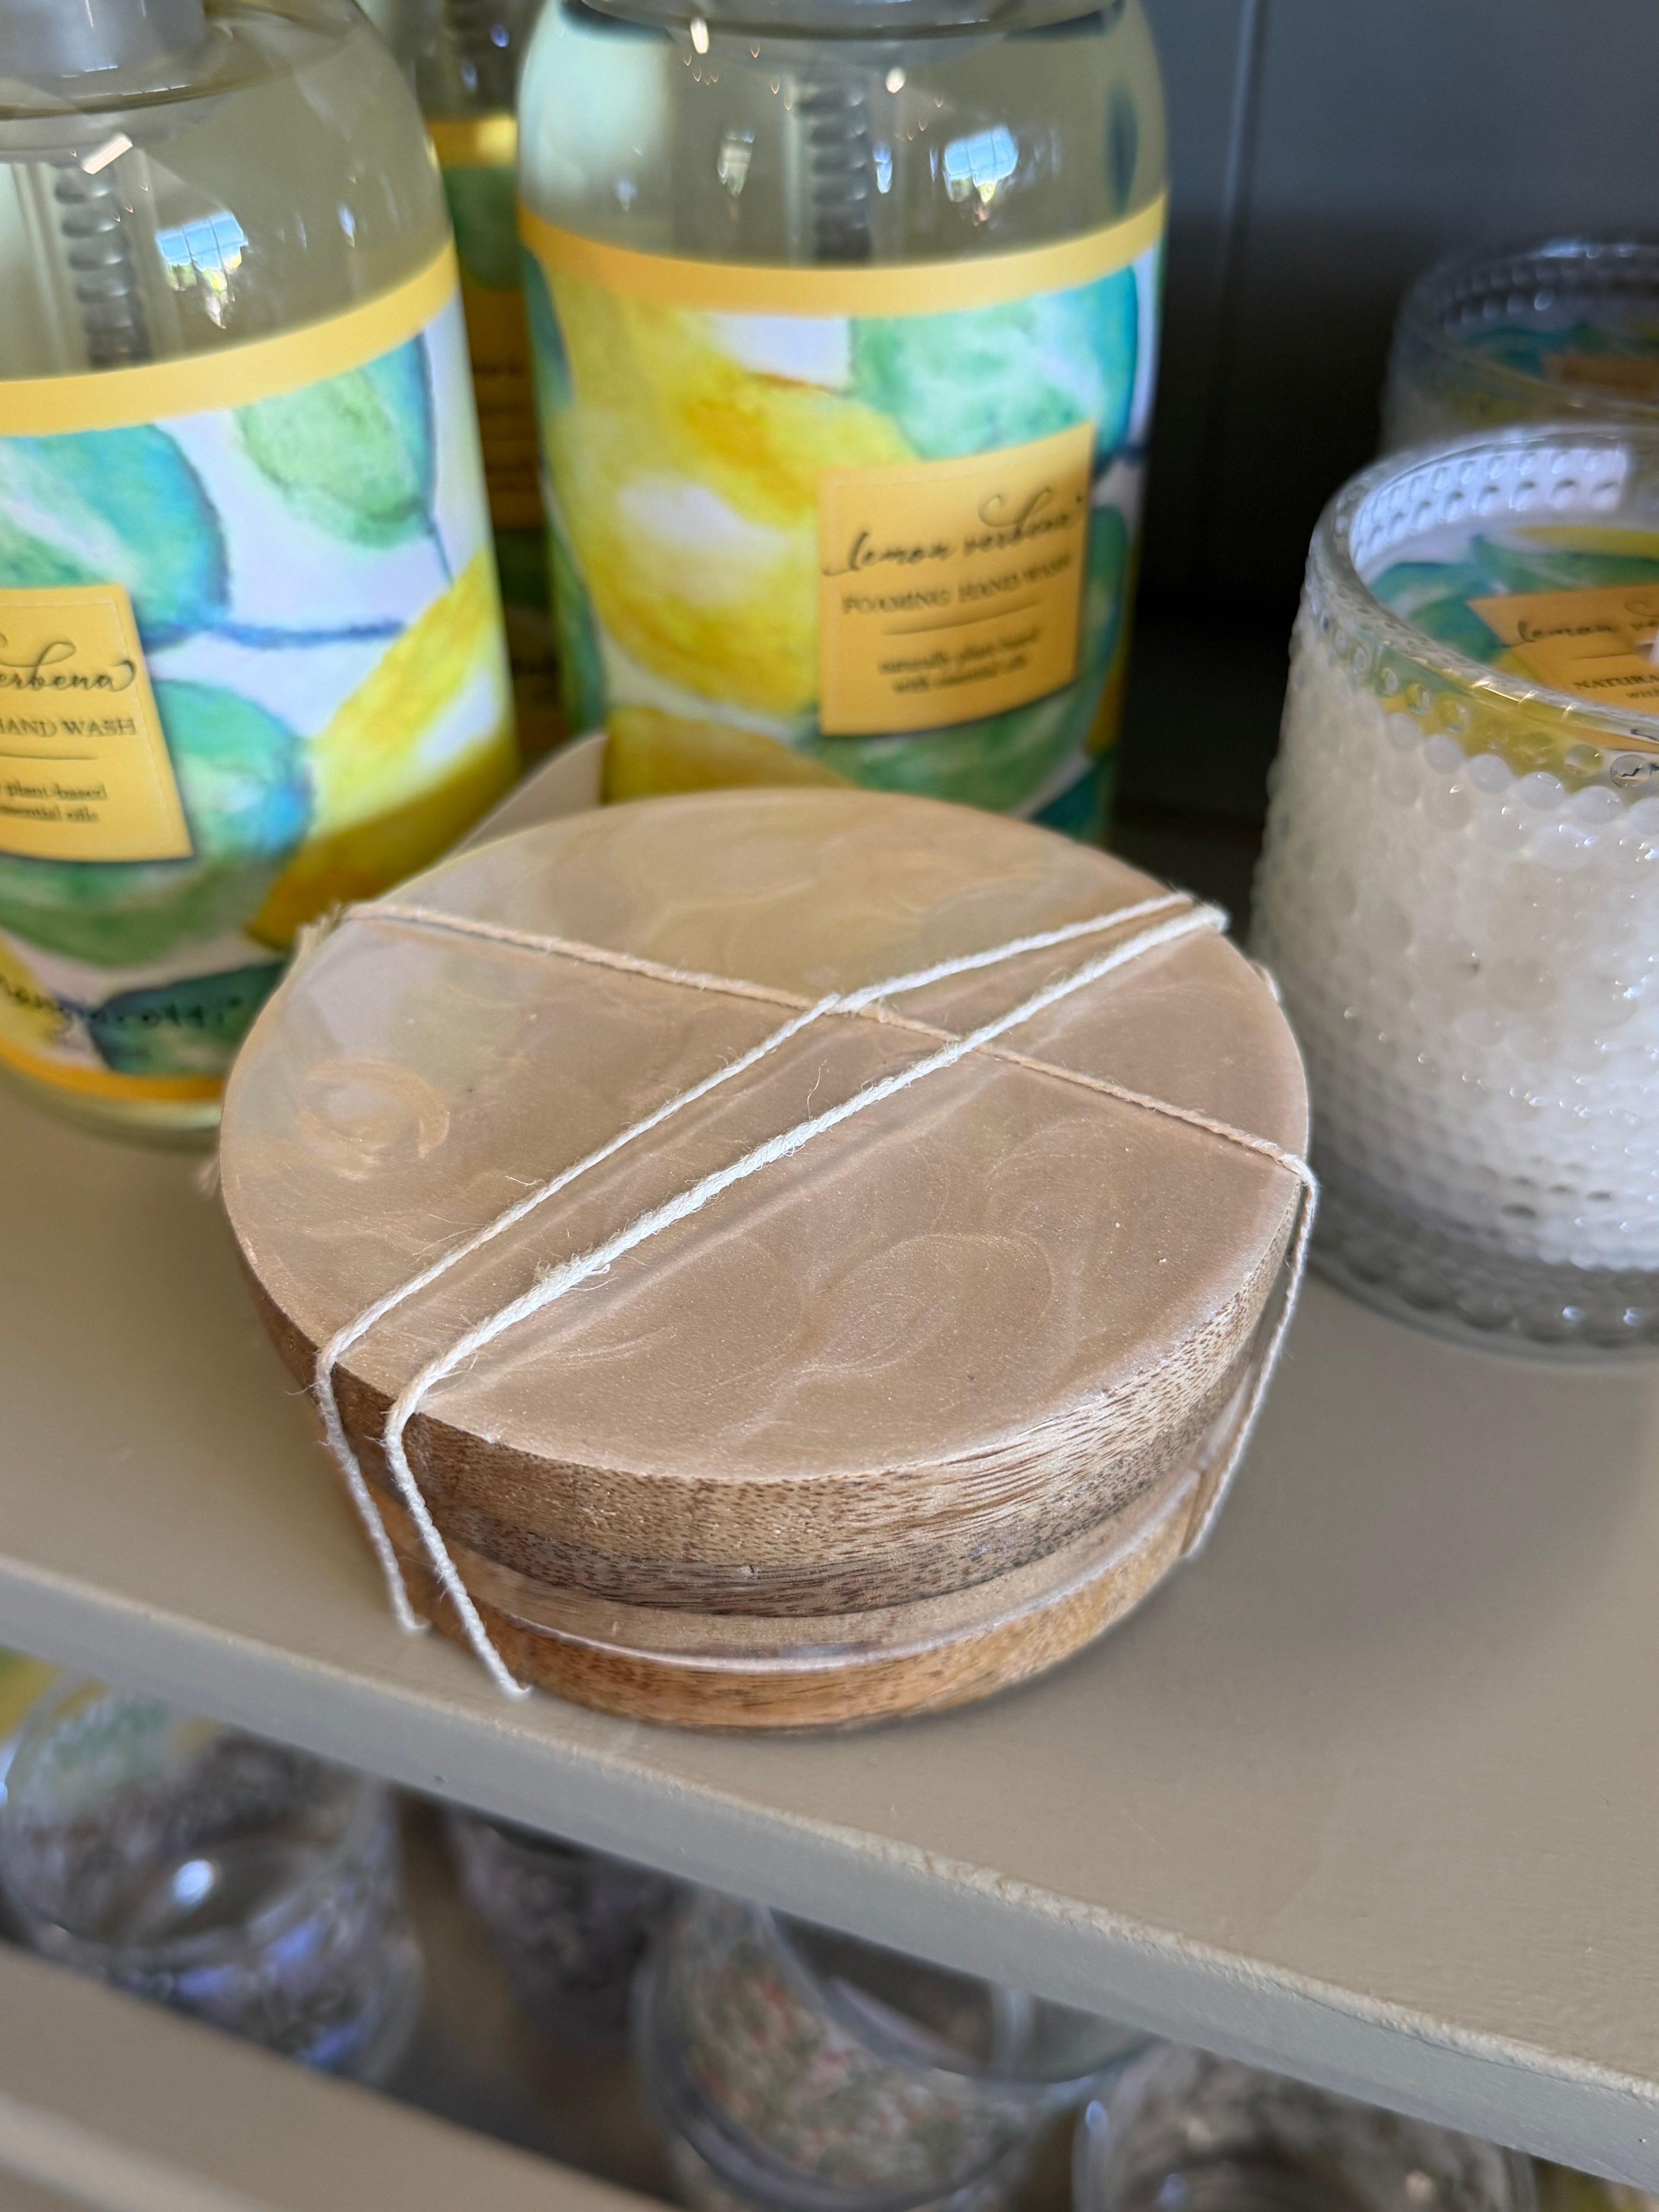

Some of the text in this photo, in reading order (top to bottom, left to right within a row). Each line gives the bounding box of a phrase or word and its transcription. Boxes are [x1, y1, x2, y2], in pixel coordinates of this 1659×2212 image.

[822, 529, 952, 577] lemon
[0, 641, 136, 692] erbena
[62, 718, 137, 735] WASH
